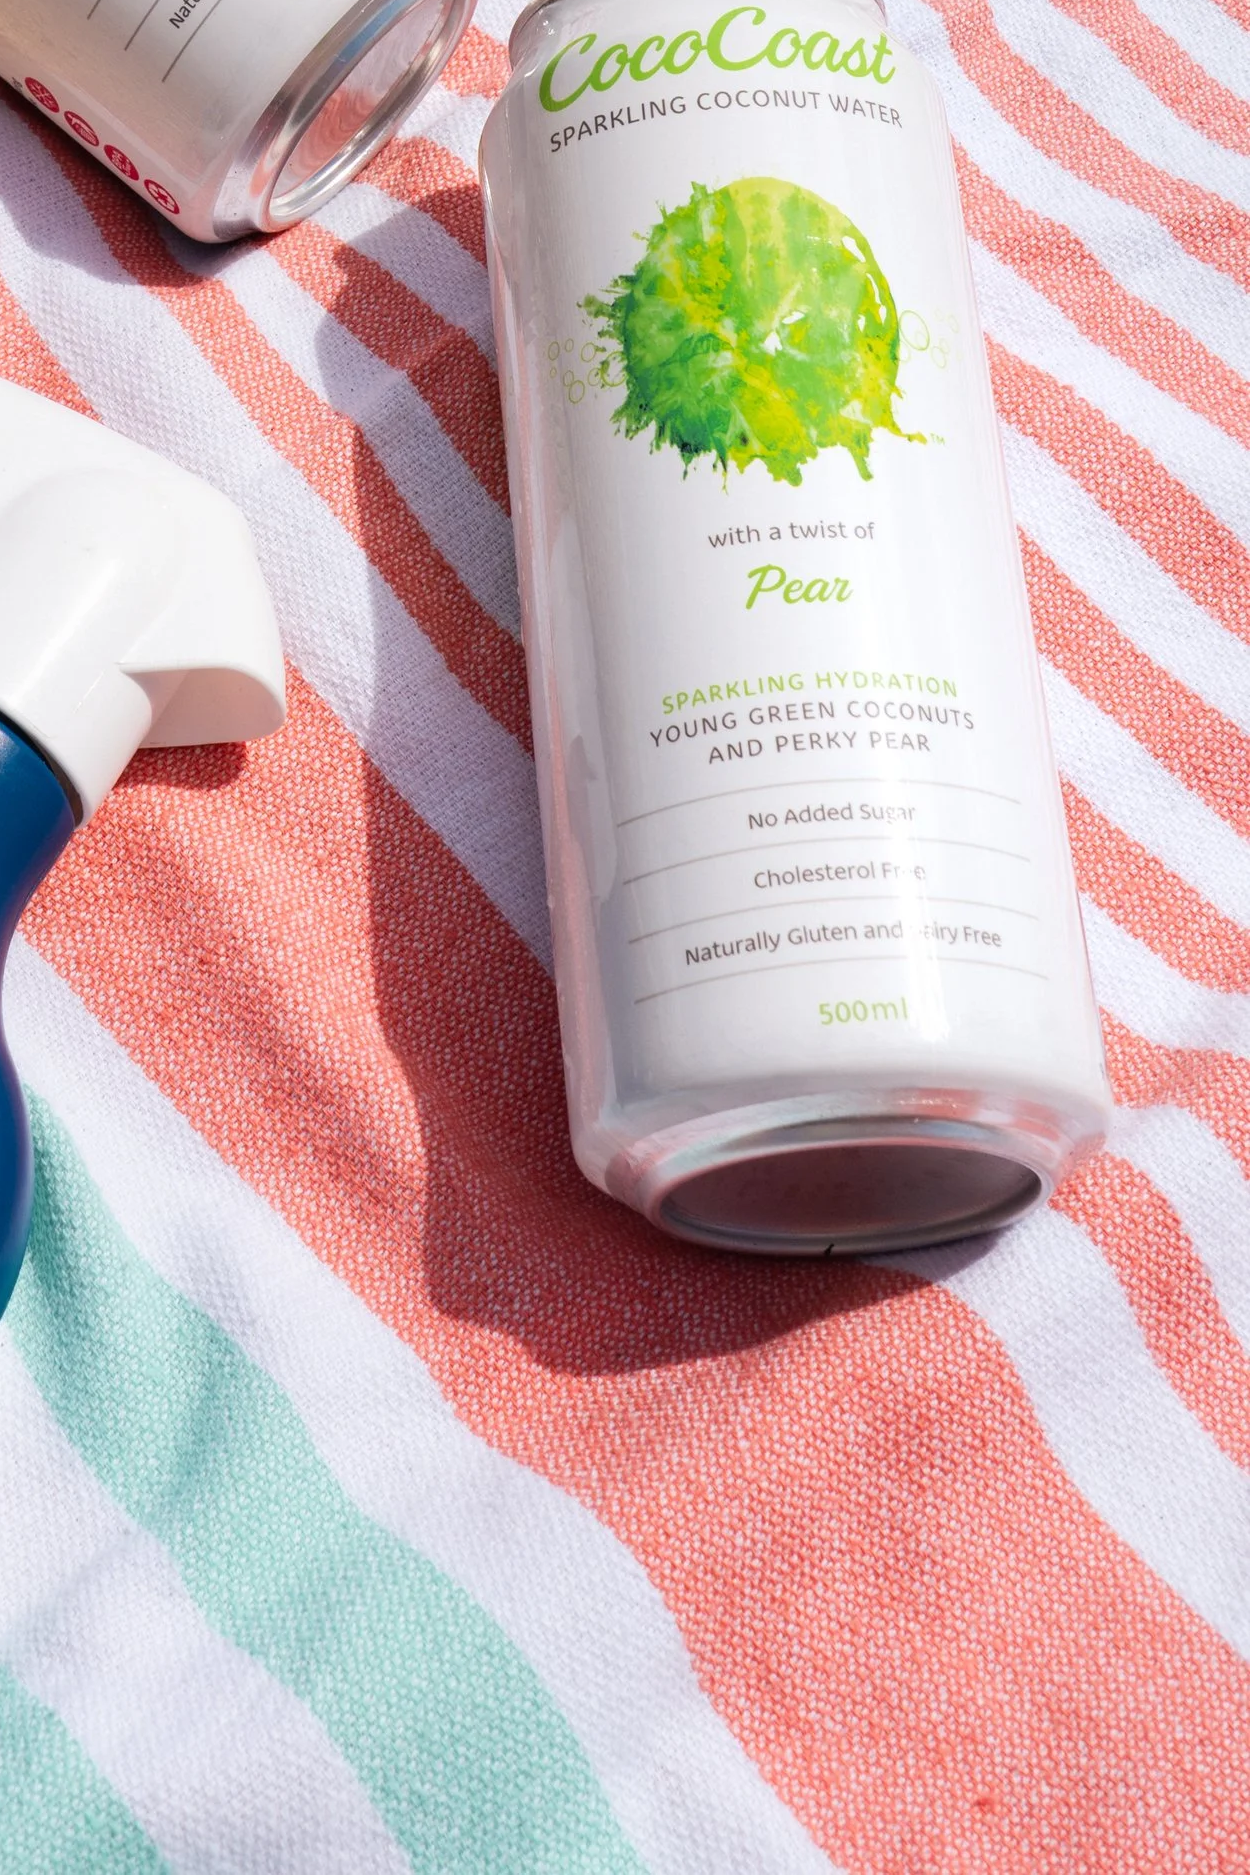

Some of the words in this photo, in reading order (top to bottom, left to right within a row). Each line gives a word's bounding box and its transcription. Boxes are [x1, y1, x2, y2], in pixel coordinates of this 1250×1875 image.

[538, 6, 896, 112] CocoCoast
[550, 95, 687, 153] SPARKLING
[696, 89, 821, 111] COCONUT
[827, 93, 903, 129] WATER
[708, 525, 761, 549] with
[768, 526, 783, 541] a
[789, 520, 848, 540] twist
[854, 521, 875, 541] of
[745, 563, 854, 610] Pear
[662, 673, 804, 715] SPARKLING
[816, 671, 957, 698] HYDRATION
[650, 712, 738, 748] YOUNG
[750, 701, 835, 725] GREEN
[847, 700, 975, 730] COCONUTS
[708, 739, 763, 765] AND
[776, 731, 857, 753] PERKY
[869, 731, 931, 752] PEAR
[748, 812, 778, 830] No
[784, 802, 853, 825] Added
[754, 861, 876, 889] Cholesterol
[881, 862, 927, 881] Fre
[685, 931, 781, 966] Naturally
[788, 924, 857, 946] Gluten
[864, 920, 903, 940] and
[963, 926, 1002, 948] Free
[818, 997, 908, 1026] 500ml
